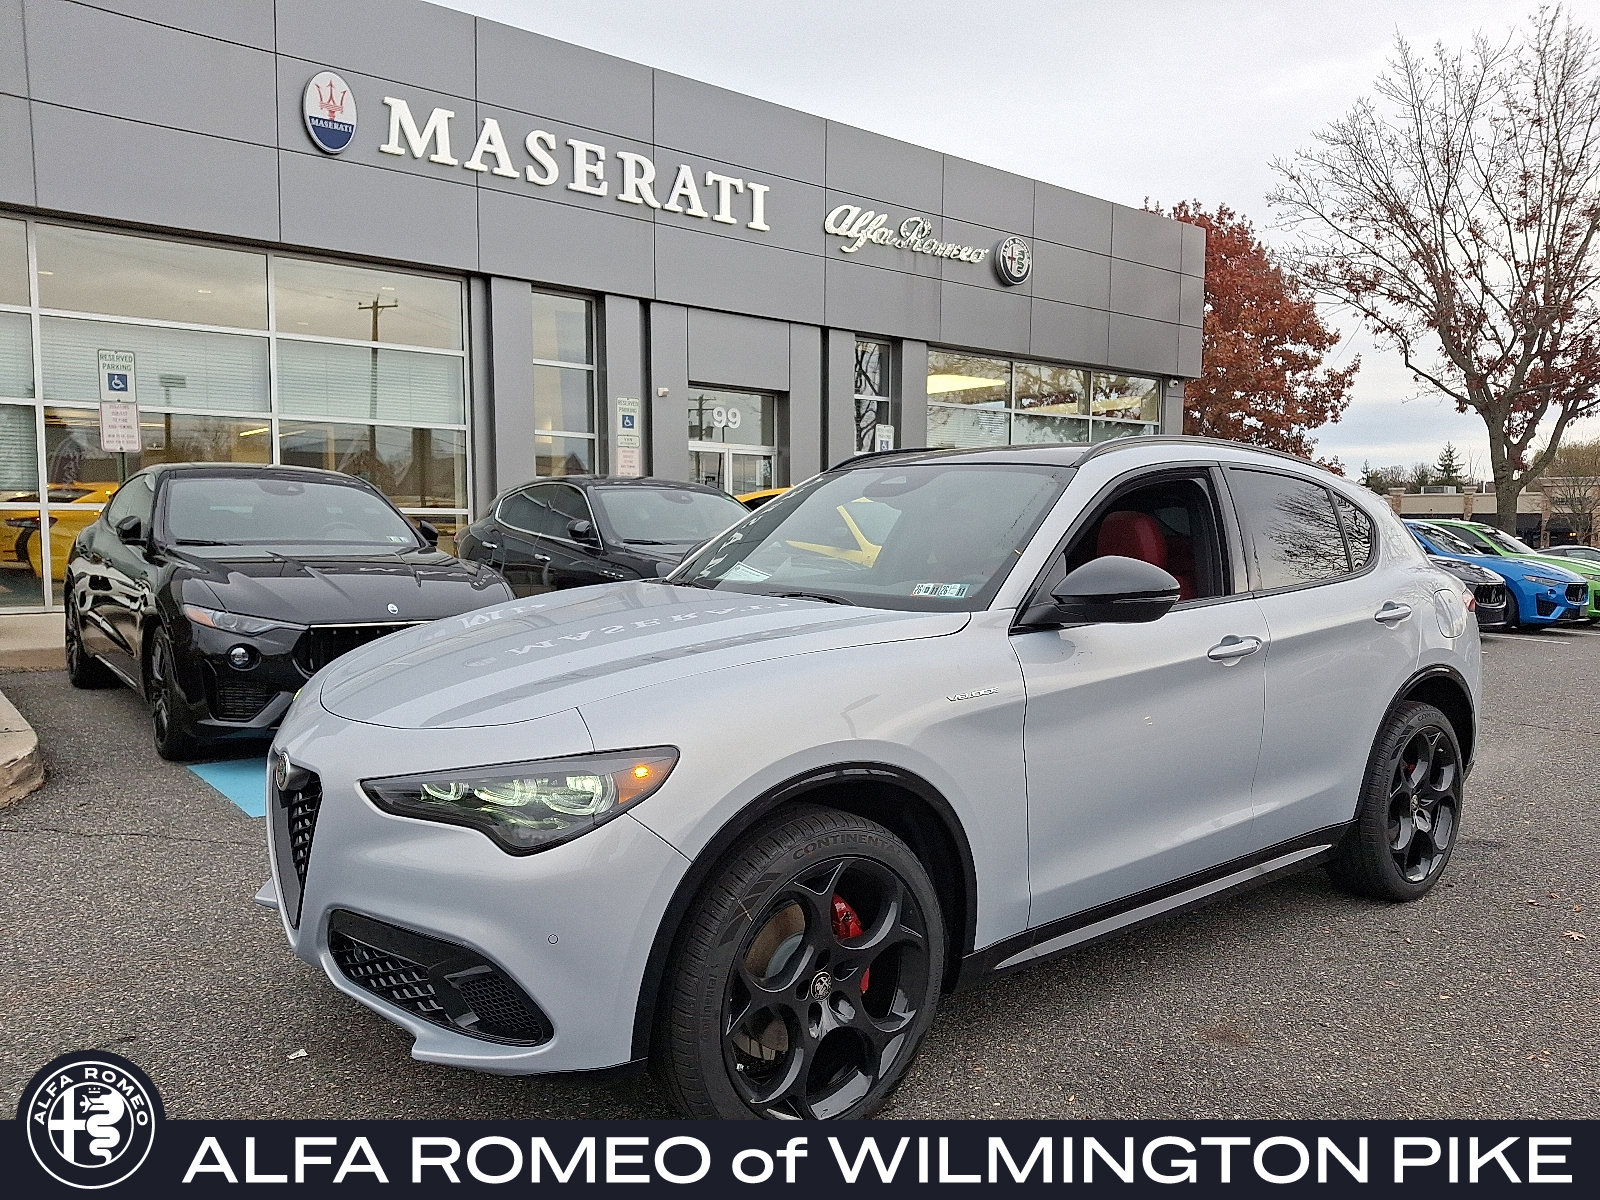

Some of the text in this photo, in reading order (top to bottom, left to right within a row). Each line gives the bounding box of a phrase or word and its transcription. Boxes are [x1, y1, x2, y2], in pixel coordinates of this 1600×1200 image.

[311, 118, 353, 133] MASERATI
[379, 96, 771, 232] MASERATI
[100, 354, 133, 363] RESERVED
[102, 363, 132, 372] PARKING
[712, 406, 742, 429] 99
